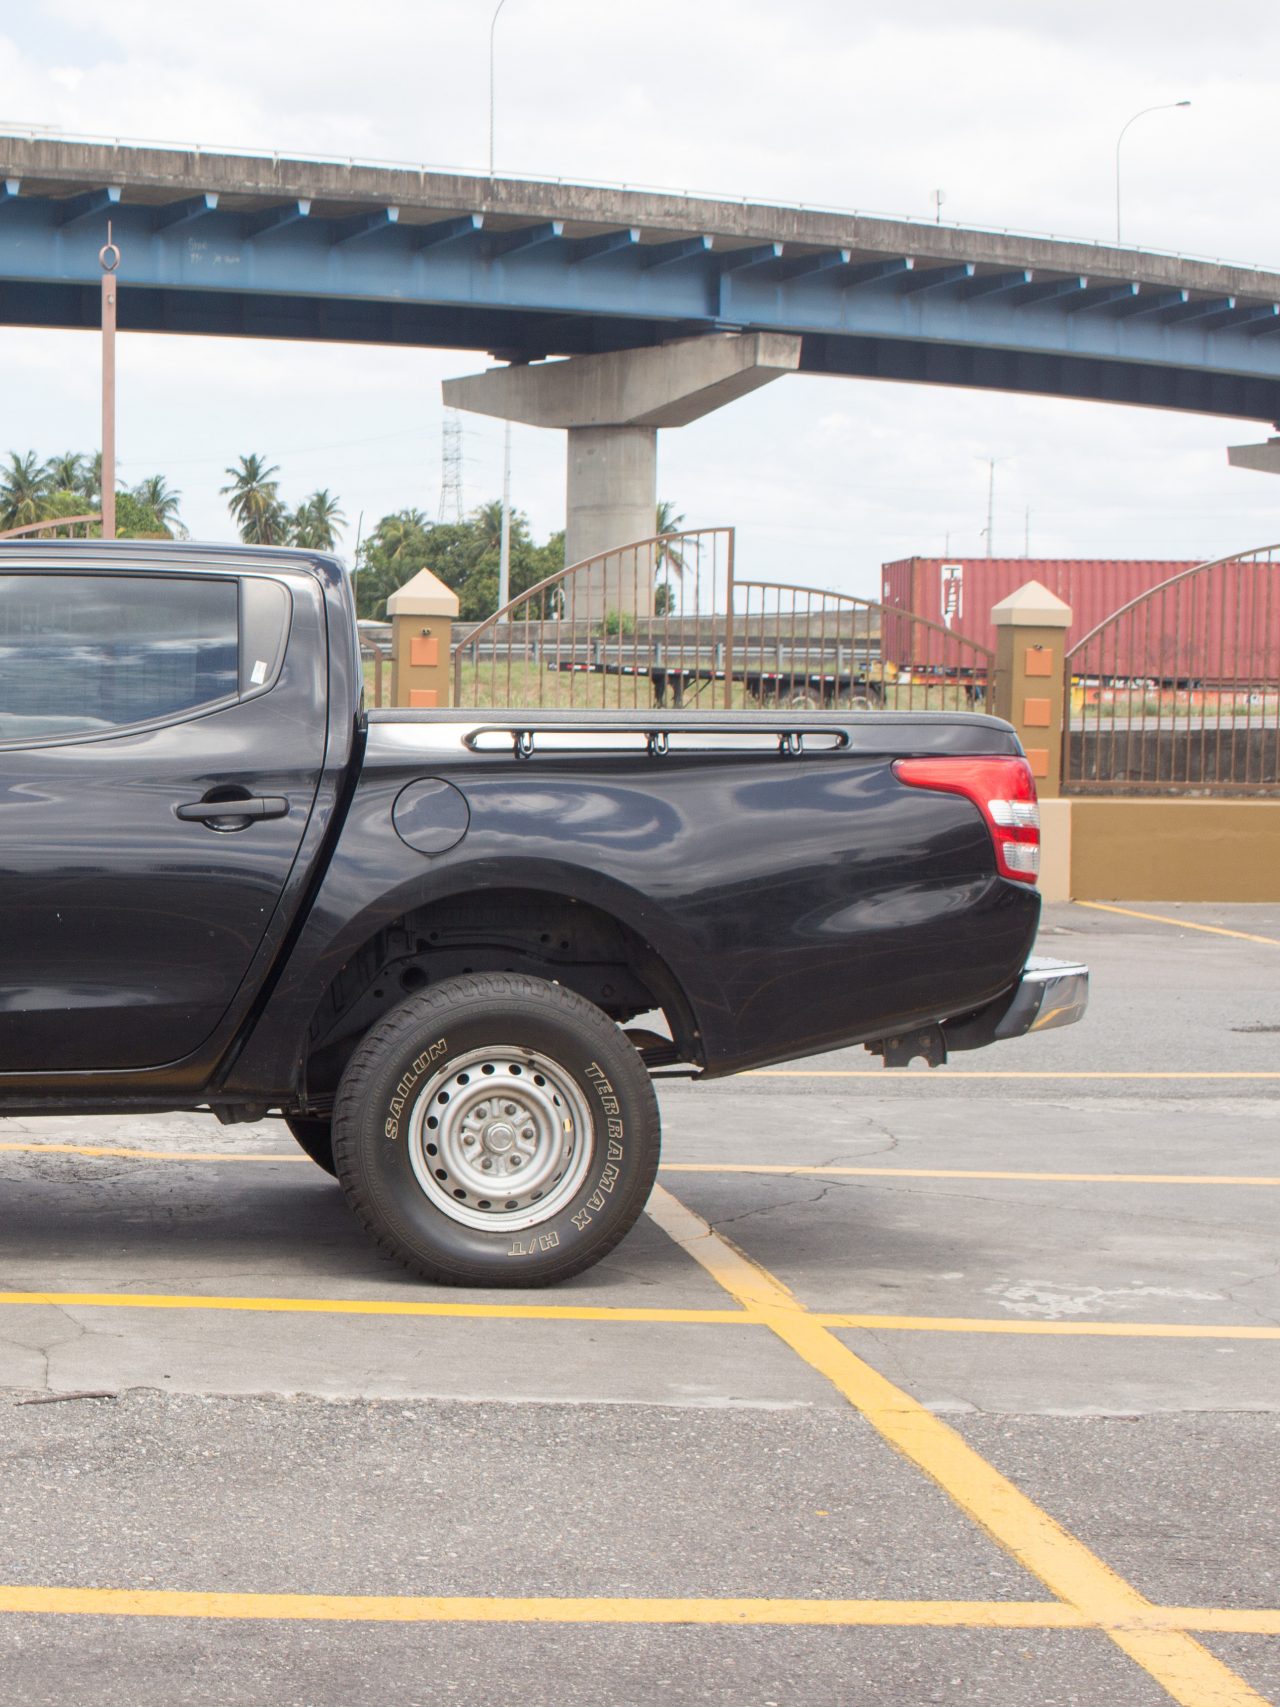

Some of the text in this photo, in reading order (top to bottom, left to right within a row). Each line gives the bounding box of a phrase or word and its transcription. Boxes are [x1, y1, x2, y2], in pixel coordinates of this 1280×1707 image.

[385, 1038, 448, 1140] SAILUN
[507, 1062, 623, 1256] TERRAMAX H/T
